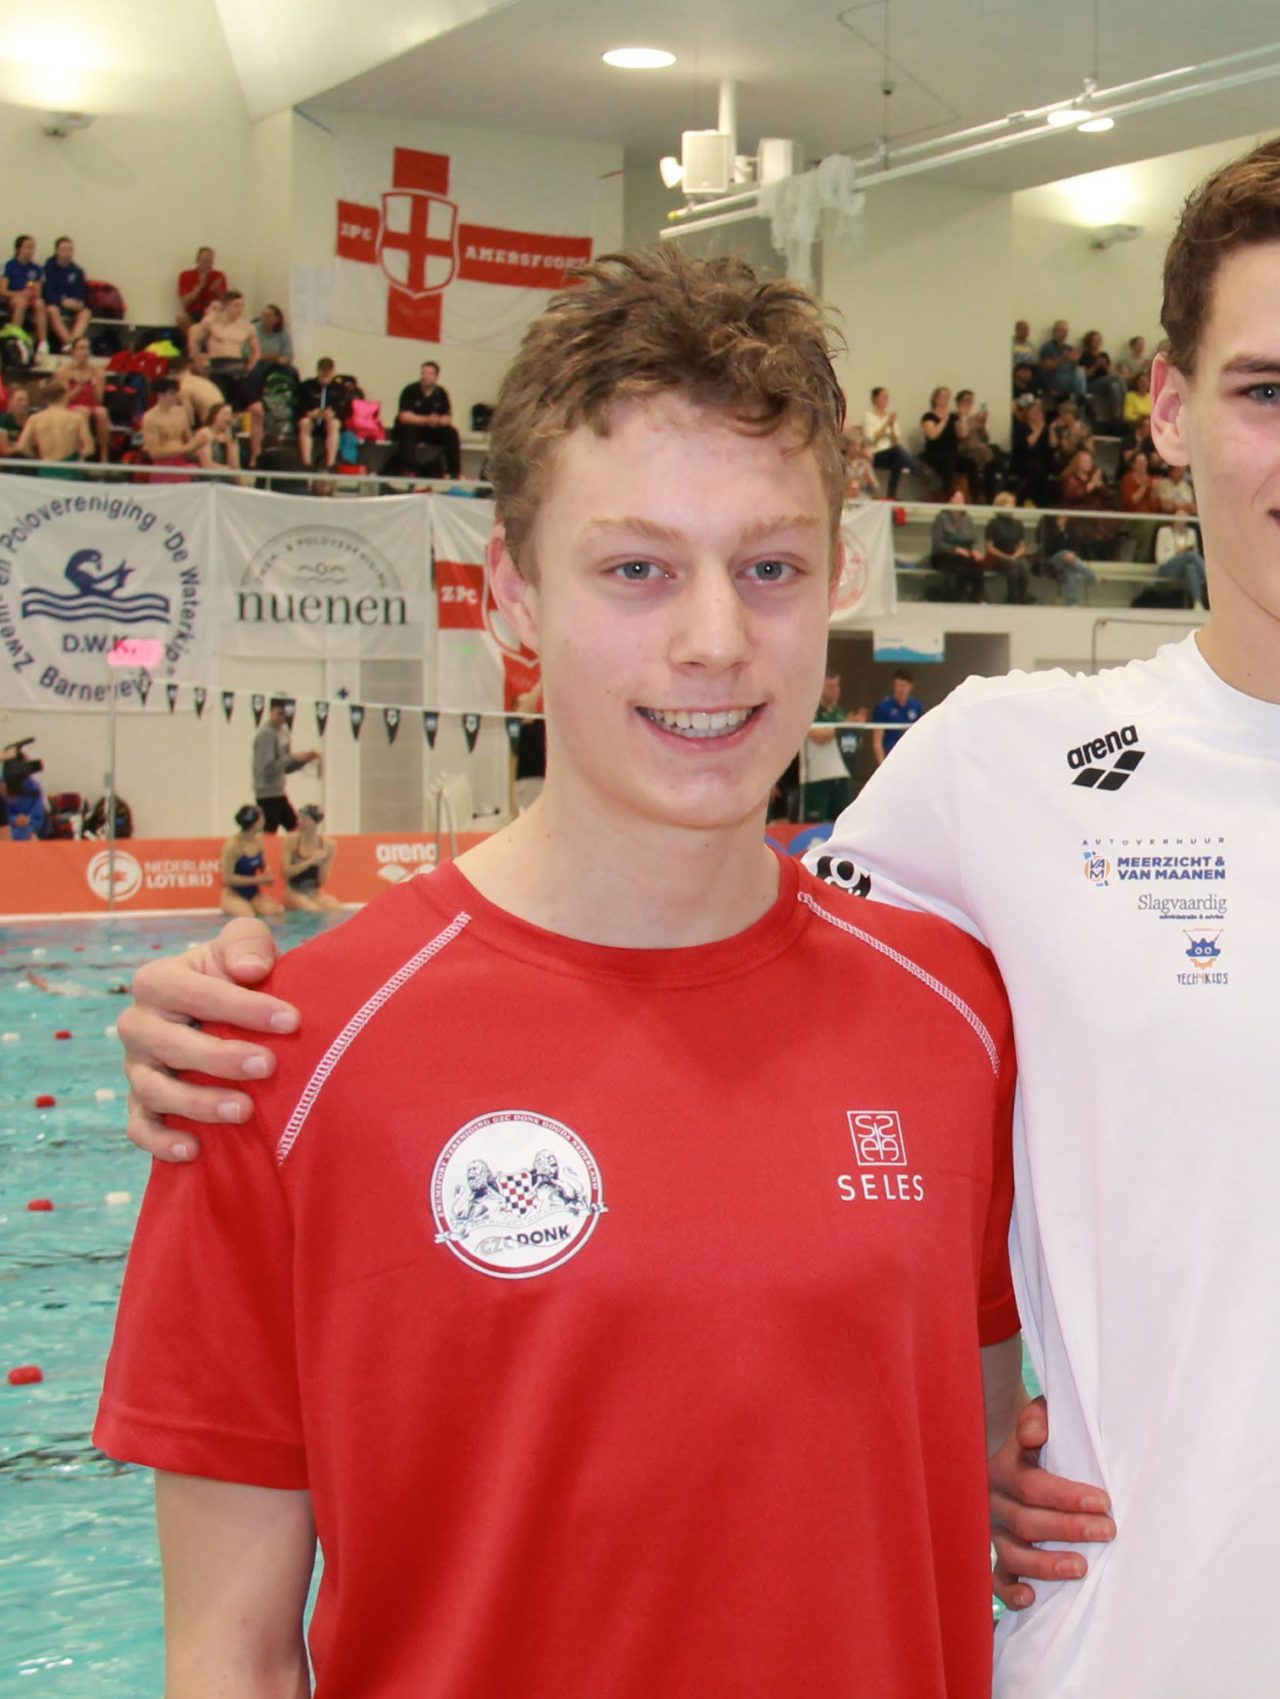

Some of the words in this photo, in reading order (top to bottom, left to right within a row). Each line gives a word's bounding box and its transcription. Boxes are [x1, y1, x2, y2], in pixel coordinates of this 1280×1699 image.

[236, 590, 410, 626] nuenen
[1067, 725, 1139, 769] arena
[1082, 837, 1225, 846] AUTOVERHUUR
[376, 843, 438, 864] arena
[1117, 856, 1212, 868] MEERZICHT
[1214, 856, 1226, 868] &
[1118, 869, 1151, 880] VAN
[1154, 869, 1226, 880] MAANEN
[1137, 893, 1228, 915] Slagvaardig
[837, 1174, 925, 1202] SELES
[516, 1225, 570, 1246] DONK
